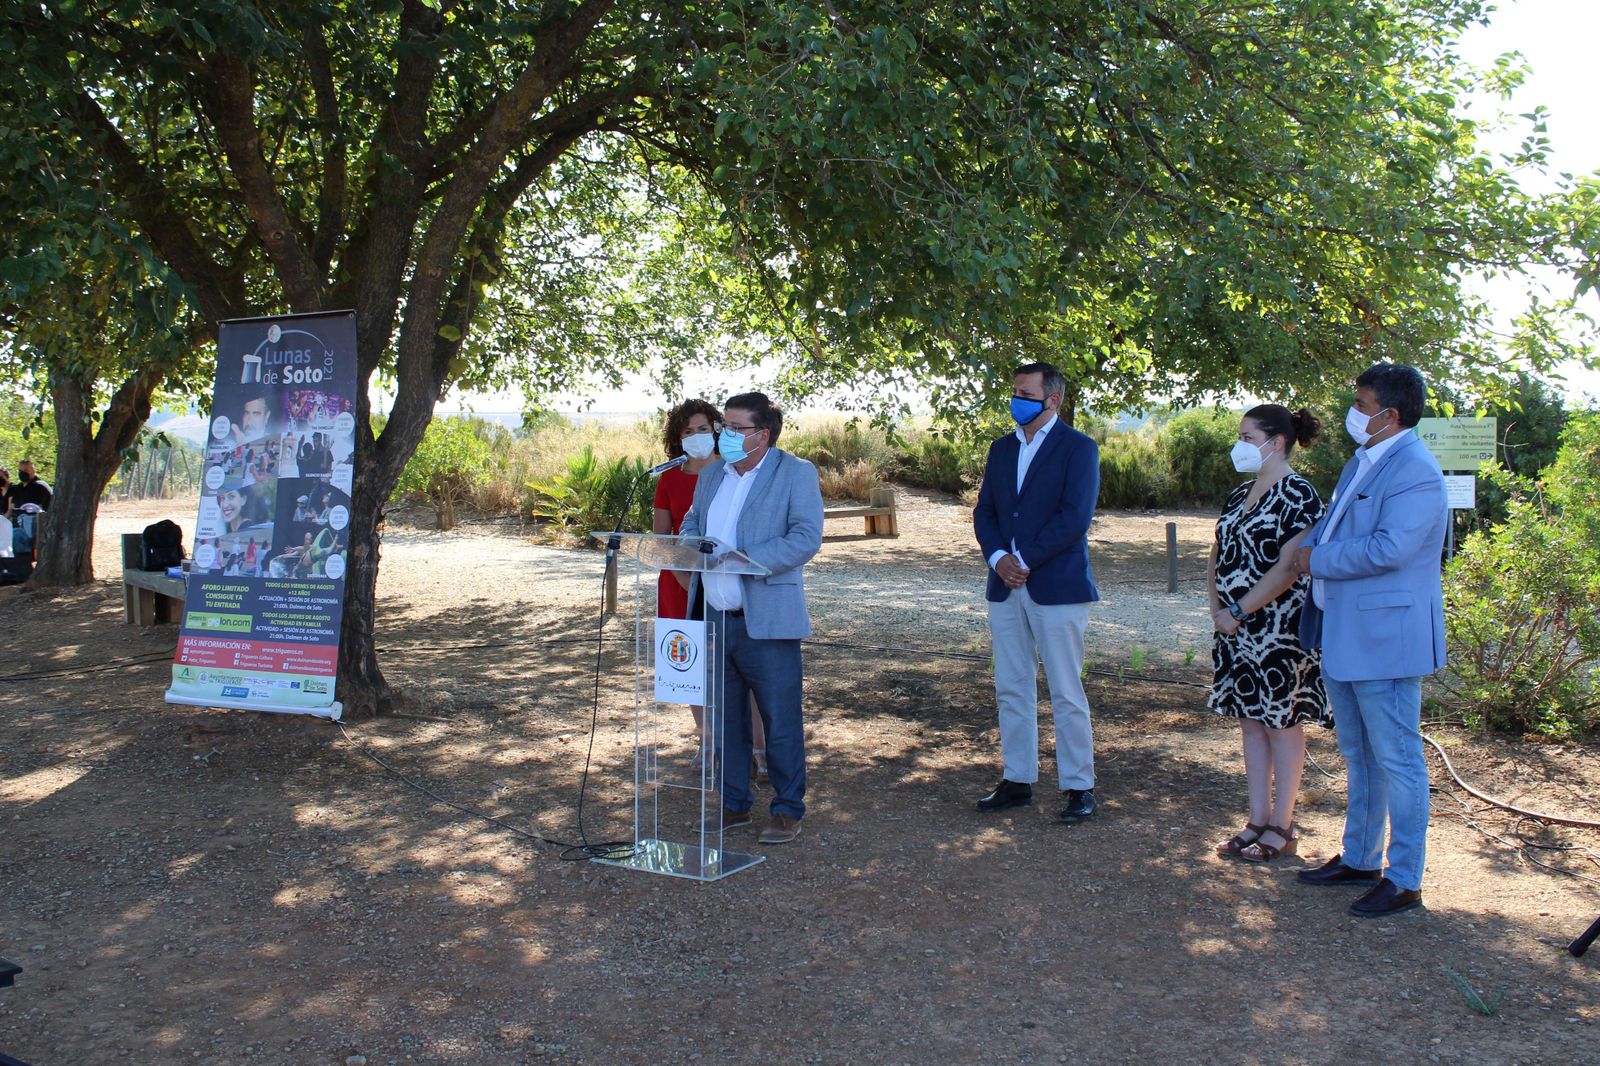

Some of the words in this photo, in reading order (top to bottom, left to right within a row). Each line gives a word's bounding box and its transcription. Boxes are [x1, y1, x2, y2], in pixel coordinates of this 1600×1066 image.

[264, 347, 311, 365] Lunas
[324, 350, 334, 380] 2021
[263, 369, 278, 384] de
[283, 365, 323, 384] Soto
[198, 640, 240, 649] INFORMACIÓN
